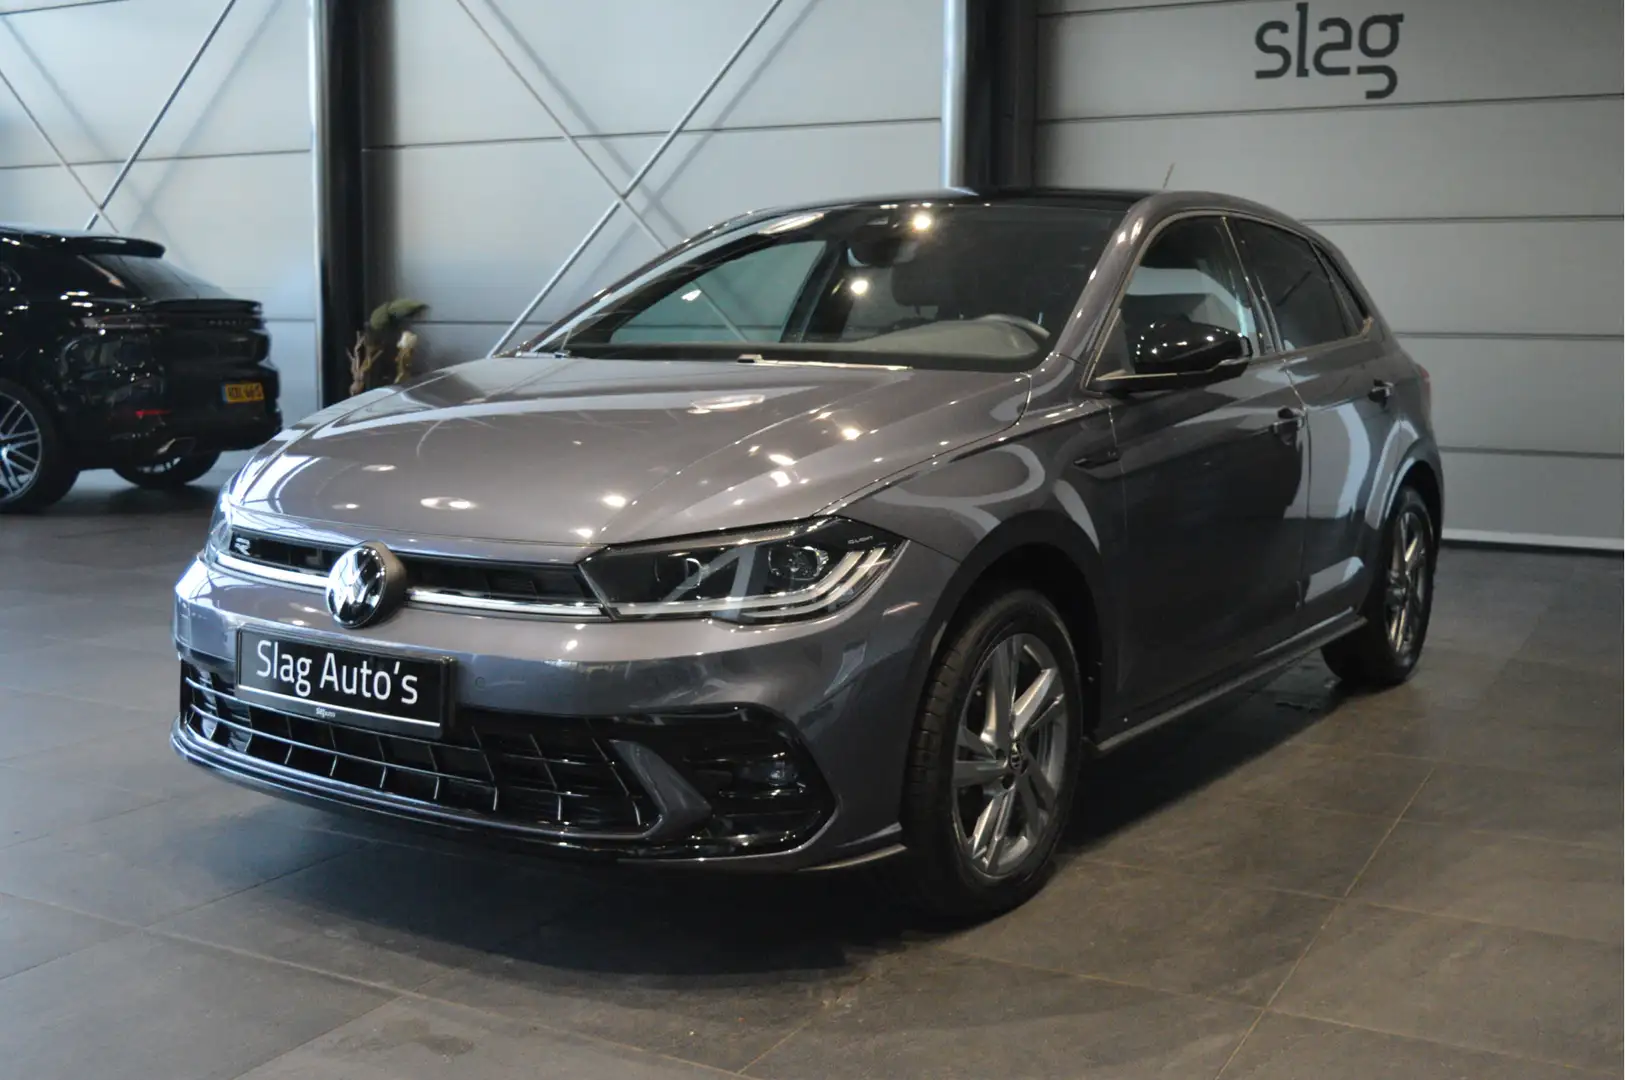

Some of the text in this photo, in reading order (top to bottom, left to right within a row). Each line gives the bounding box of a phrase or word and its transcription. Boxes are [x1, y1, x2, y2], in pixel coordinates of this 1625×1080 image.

[1255, 2, 1404, 99] slag
[256, 639, 418, 705] Slag Auto's
